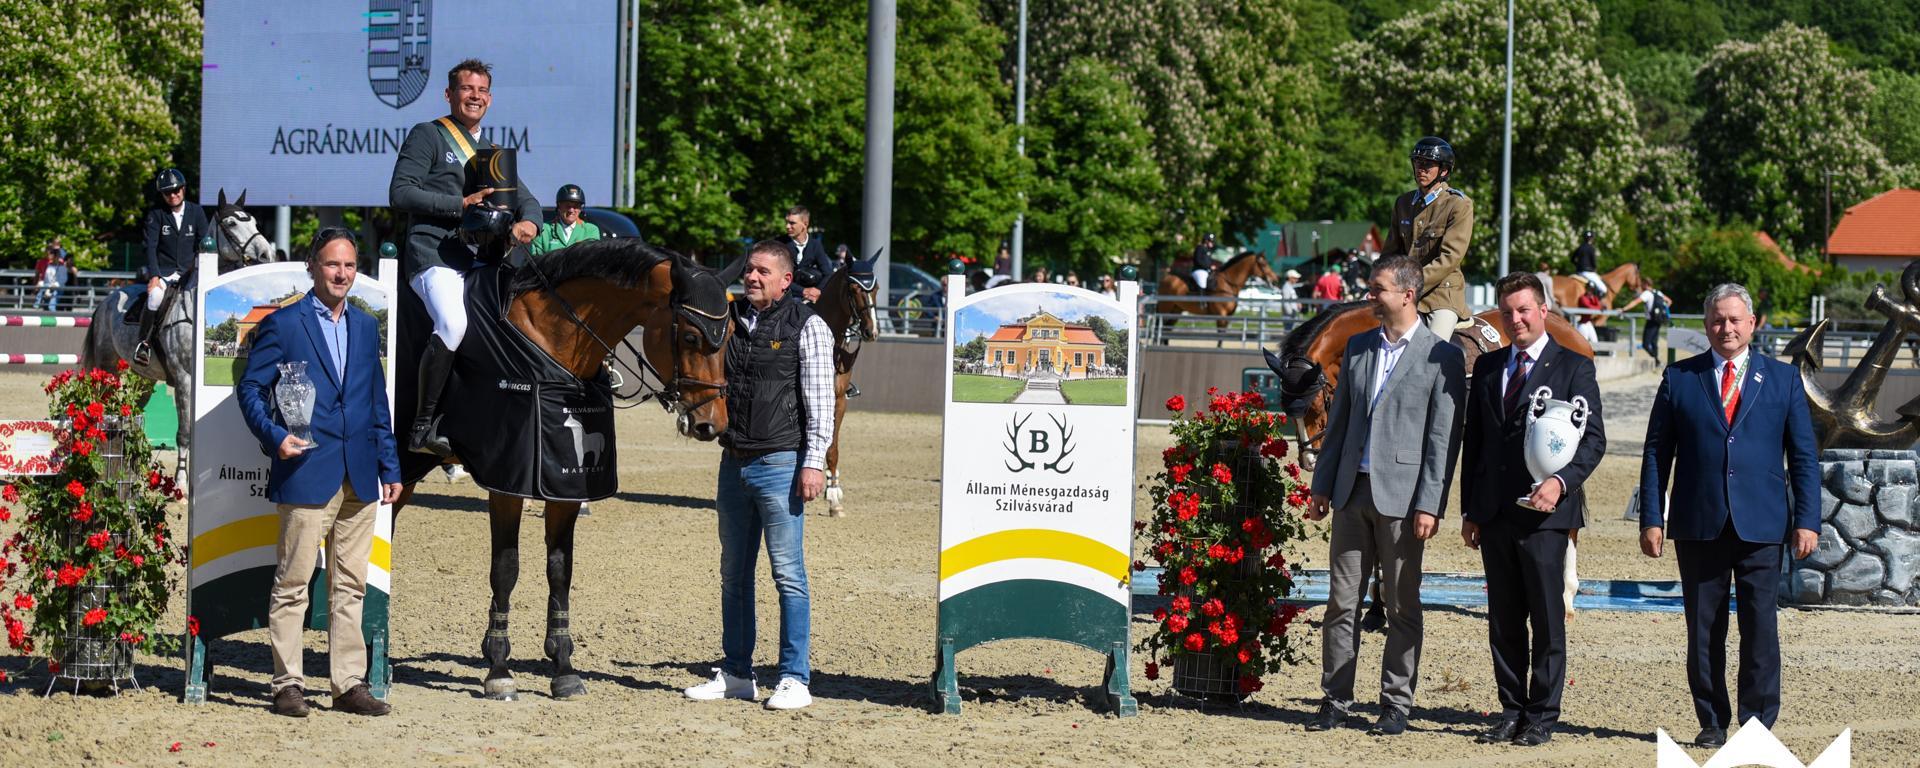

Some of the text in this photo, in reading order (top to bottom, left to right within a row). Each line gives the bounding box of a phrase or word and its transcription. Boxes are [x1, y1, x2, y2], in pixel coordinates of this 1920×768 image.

[270, 123, 530, 154] AGRÁRMINIUM
[1028, 429, 1050, 454] B
[219, 464, 261, 480] Állami
[966, 480, 1109, 501] Állami Ménesgazdaság
[995, 498, 1073, 513] Szilvásvárad
